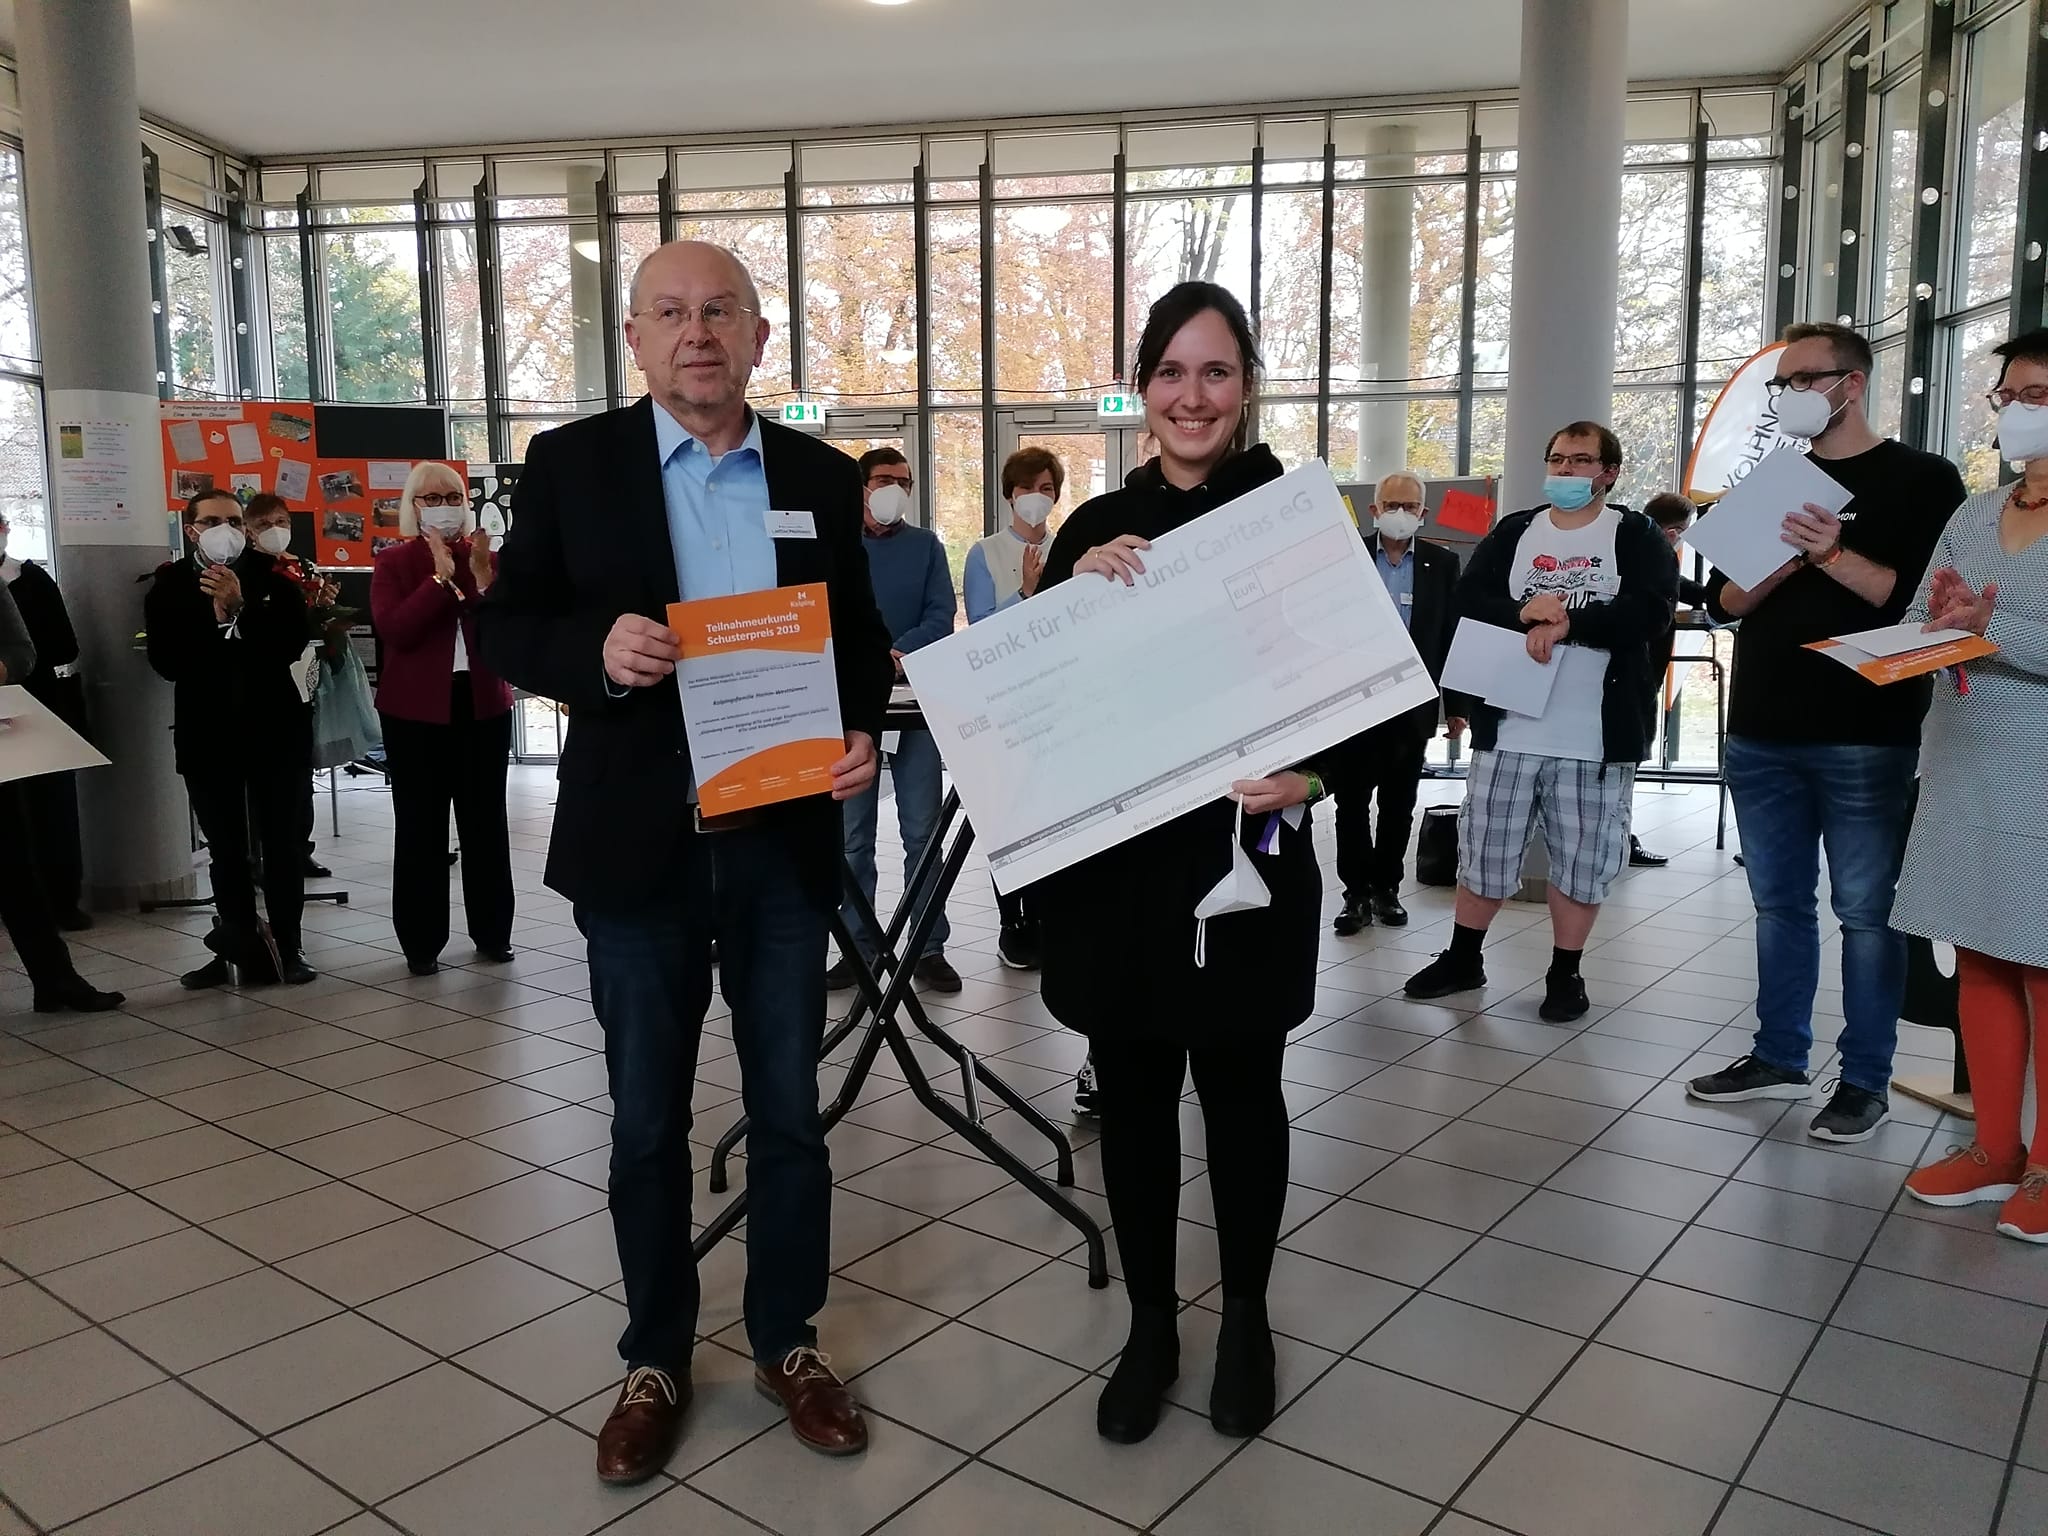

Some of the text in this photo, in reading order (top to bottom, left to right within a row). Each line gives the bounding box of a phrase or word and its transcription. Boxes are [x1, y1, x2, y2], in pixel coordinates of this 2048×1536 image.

[964, 631, 1027, 672] Bank
[1028, 613, 1062, 646] für
[1144, 548, 1190, 590] und
[1194, 513, 1275, 564] Caritas
[1280, 490, 1314, 524] eG
[1230, 579, 1259, 601] EUR
[705, 611, 799, 633] Teilnahmeurkunde
[706, 624, 801, 646] Schusterpreis 2019
